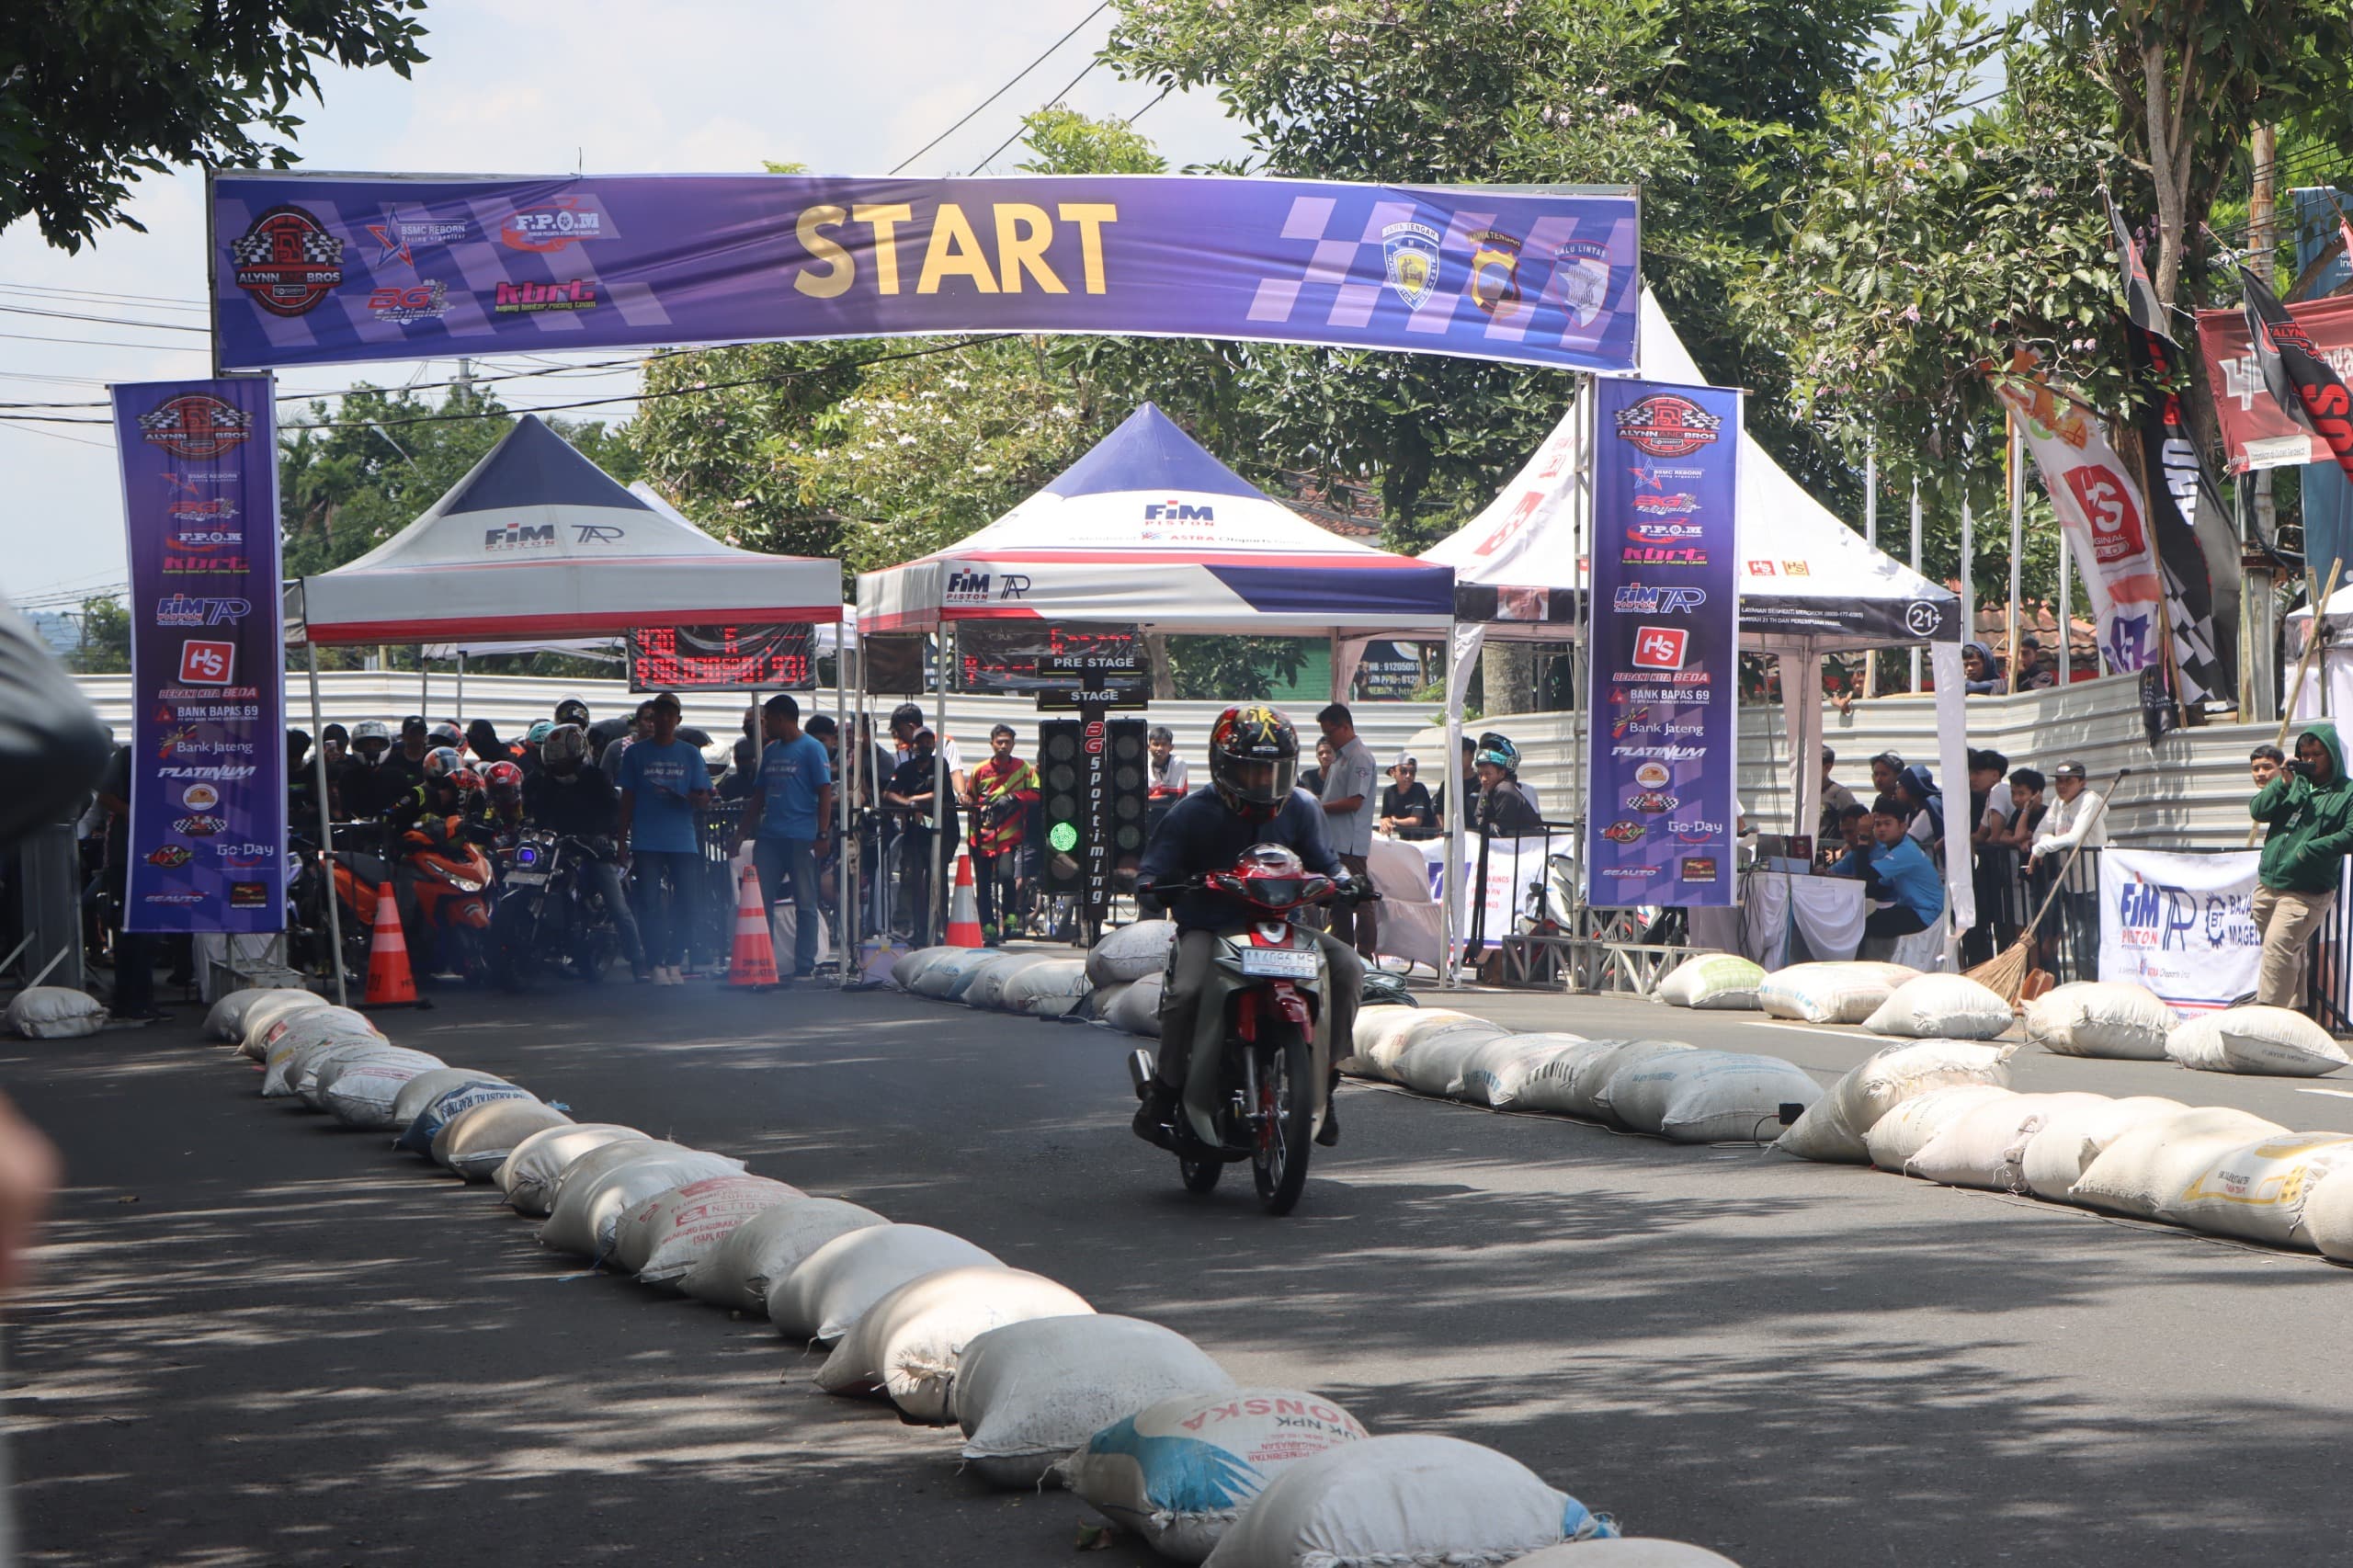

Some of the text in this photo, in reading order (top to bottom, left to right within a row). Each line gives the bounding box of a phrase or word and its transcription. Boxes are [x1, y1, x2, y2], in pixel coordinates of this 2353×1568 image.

[516, 211, 599, 231] F.P.O.M
[401, 224, 466, 235] BSMC REBORN
[1407, 223, 1437, 238] TENGAH
[793, 203, 1118, 298] START
[1554, 244, 1607, 258] LALU LINTAS
[239, 272, 279, 282] ALYNN
[307, 272, 340, 282] BROS
[368, 287, 433, 310] BG
[574, 301, 597, 309] team
[145, 431, 249, 441] ALYNN BROS
[1619, 429, 1658, 437] ALYNN
[1684, 432, 1717, 440] BROS
[2094, 535, 2126, 546] GINAL
[156, 613, 202, 621] PISTON
[1911, 608, 1942, 628] 21+
[1643, 634, 1676, 661] HS
[189, 648, 223, 676] HS
[1053, 657, 1134, 667] PRE STAGE
[1613, 672, 1709, 683] BERANI KITA BEDA
[158, 687, 257, 699] BERANI KITA BEDA
[1071, 691, 1119, 701] STAGE
[1631, 689, 1710, 700] BANK BAPAS 69
[177, 705, 258, 717] BANK BAPAS 69
[1630, 722, 1704, 736] Bank Jateng
[176, 741, 253, 756] Bank Jateng
[1610, 744, 1707, 761] PLATINUM
[157, 765, 256, 781] PLATINUM
[1667, 821, 1722, 834] Go-Day
[216, 843, 274, 857] Go-Day
[2211, 912, 2224, 928] BT
[2121, 929, 2157, 945] PISTON
[2229, 926, 2264, 947] MAGEL
[712, 1202, 756, 1212] NETTO
[1275, 1416, 1321, 1429] NPK
